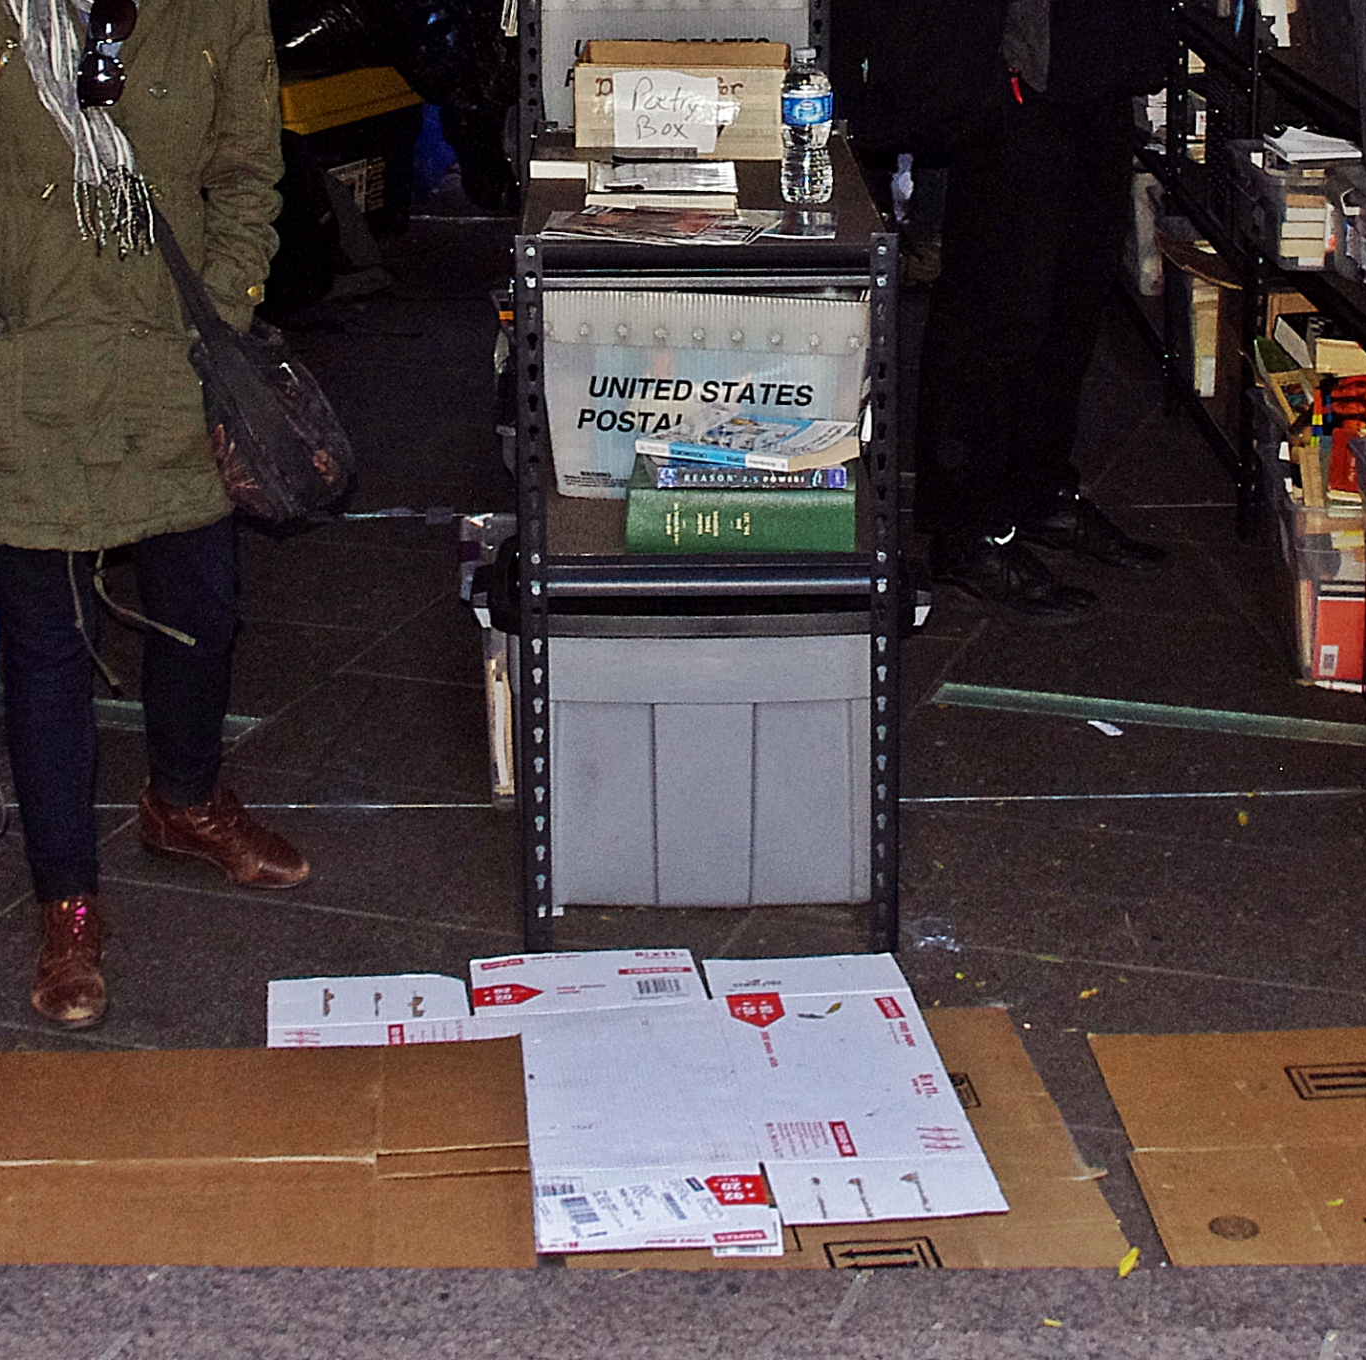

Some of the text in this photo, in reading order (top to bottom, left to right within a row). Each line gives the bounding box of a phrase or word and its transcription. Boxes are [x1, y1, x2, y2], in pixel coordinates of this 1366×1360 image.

[631, 76, 701, 121] Poetry
[638, 115, 688, 140] Box
[588, 375, 814, 407] UNITED STATES
[684, 473, 734, 483] REASON
